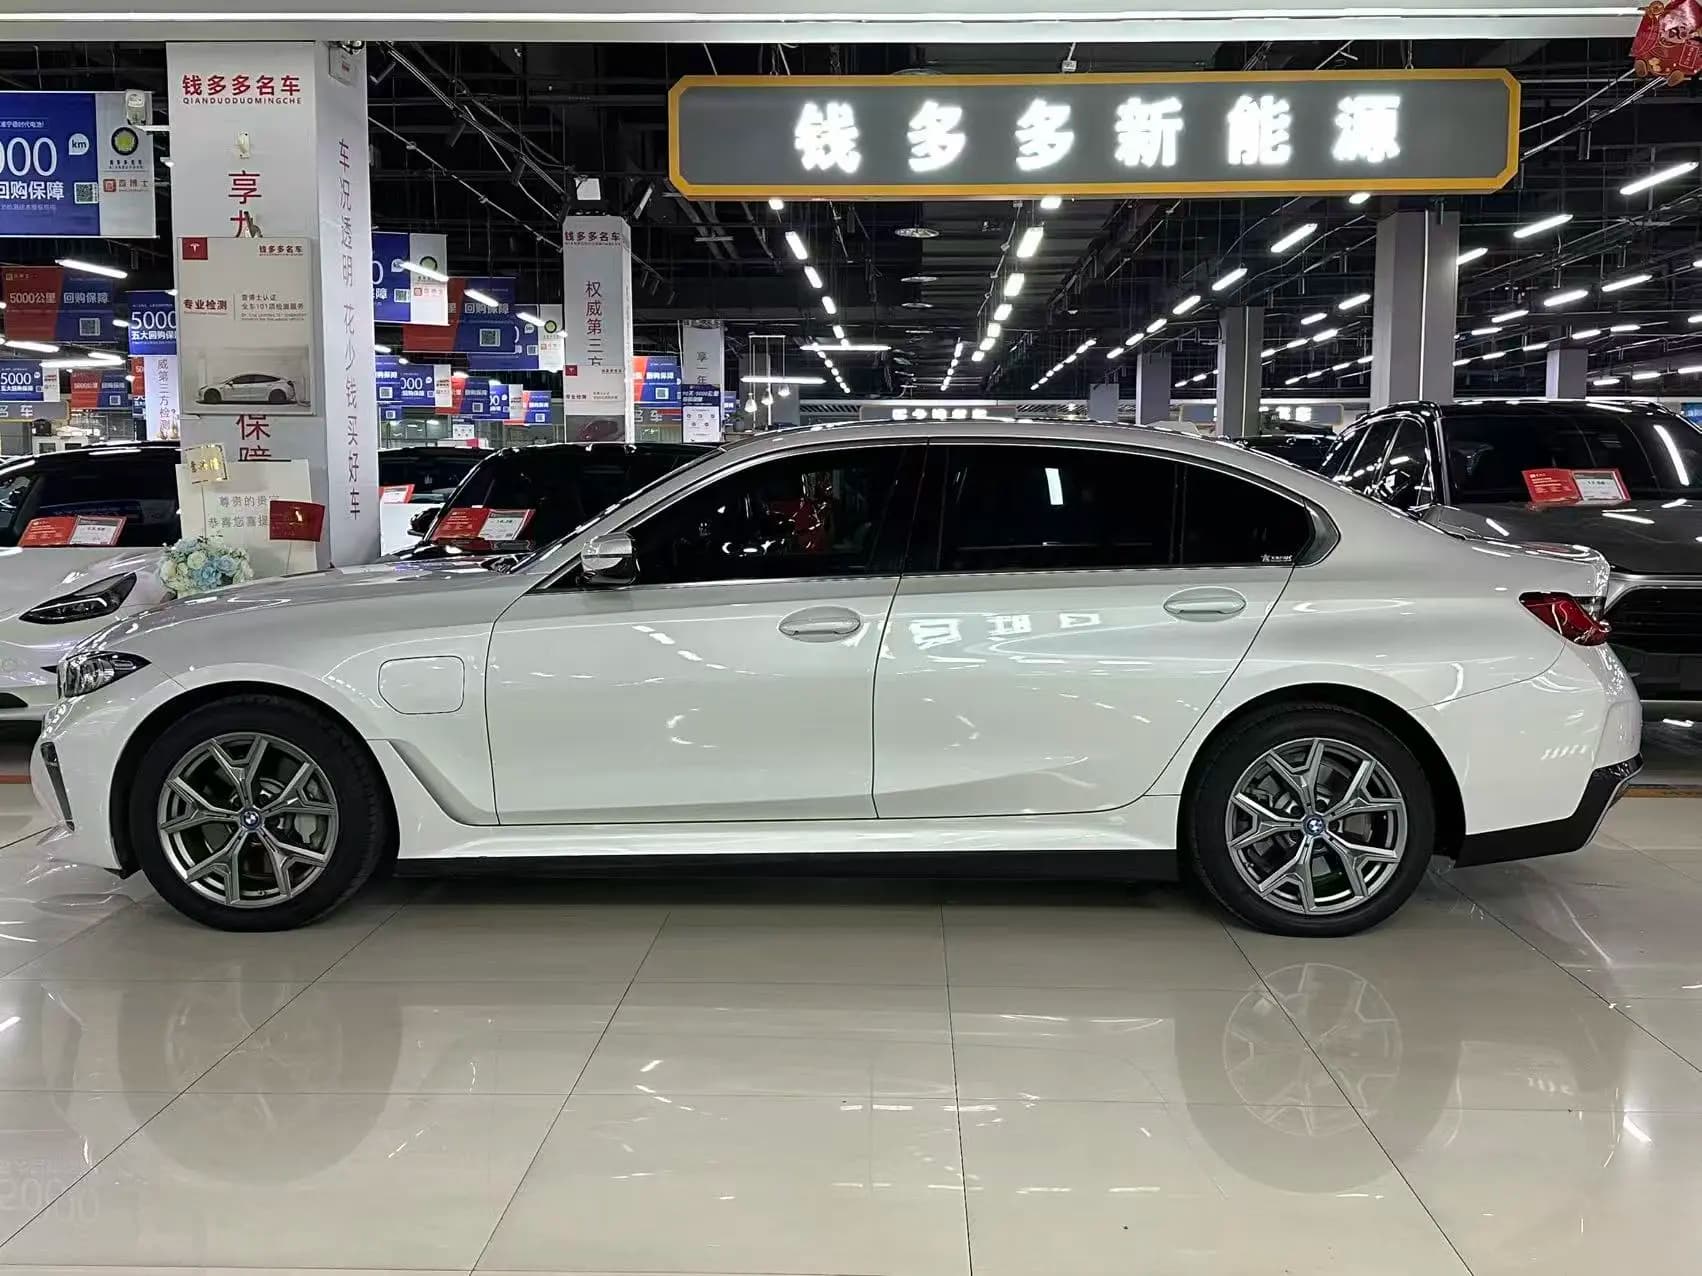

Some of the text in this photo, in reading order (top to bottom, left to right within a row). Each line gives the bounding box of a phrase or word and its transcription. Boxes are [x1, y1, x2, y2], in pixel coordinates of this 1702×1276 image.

[182, 75, 301, 96] 钱多多名车
[794, 94, 1402, 173] 钱多多新能源
[71, 139, 87, 148] km
[564, 231, 621, 242] 钱多多名车
[10, 292, 108, 304] 5000公里 回购保障
[183, 299, 228, 311] 专业检测
[131, 331, 176, 340] 五大回购保
[0, 372, 31, 385] 5000
[344, 304, 360, 521] 花少钱买好车
[219, 495, 280, 507] 尊贵的贵
